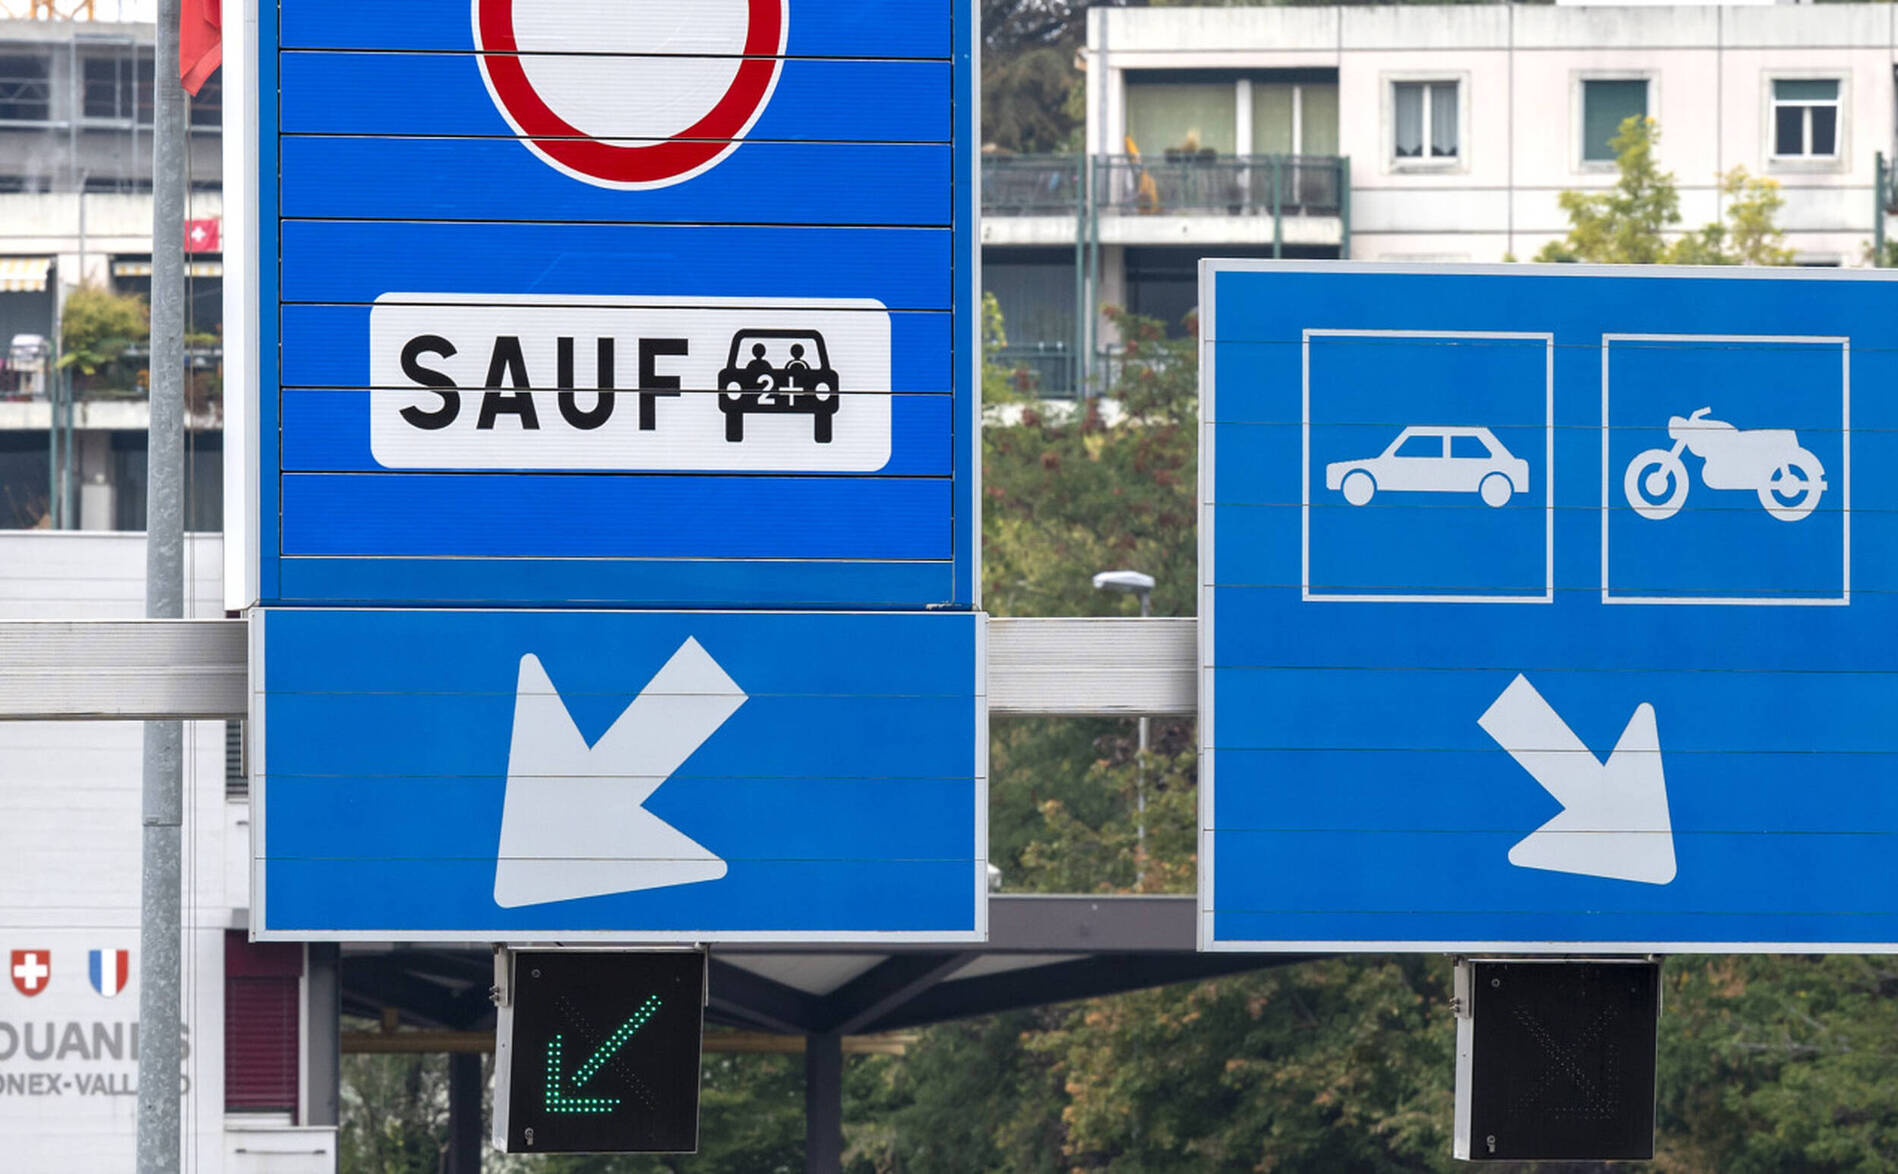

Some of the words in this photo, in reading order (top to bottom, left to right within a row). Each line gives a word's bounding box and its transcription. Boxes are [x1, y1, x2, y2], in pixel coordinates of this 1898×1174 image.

[399, 334, 689, 431] SAUF
[757, 374, 804, 406] 2+
[0, 1073, 190, 1096] NEX-VALL
